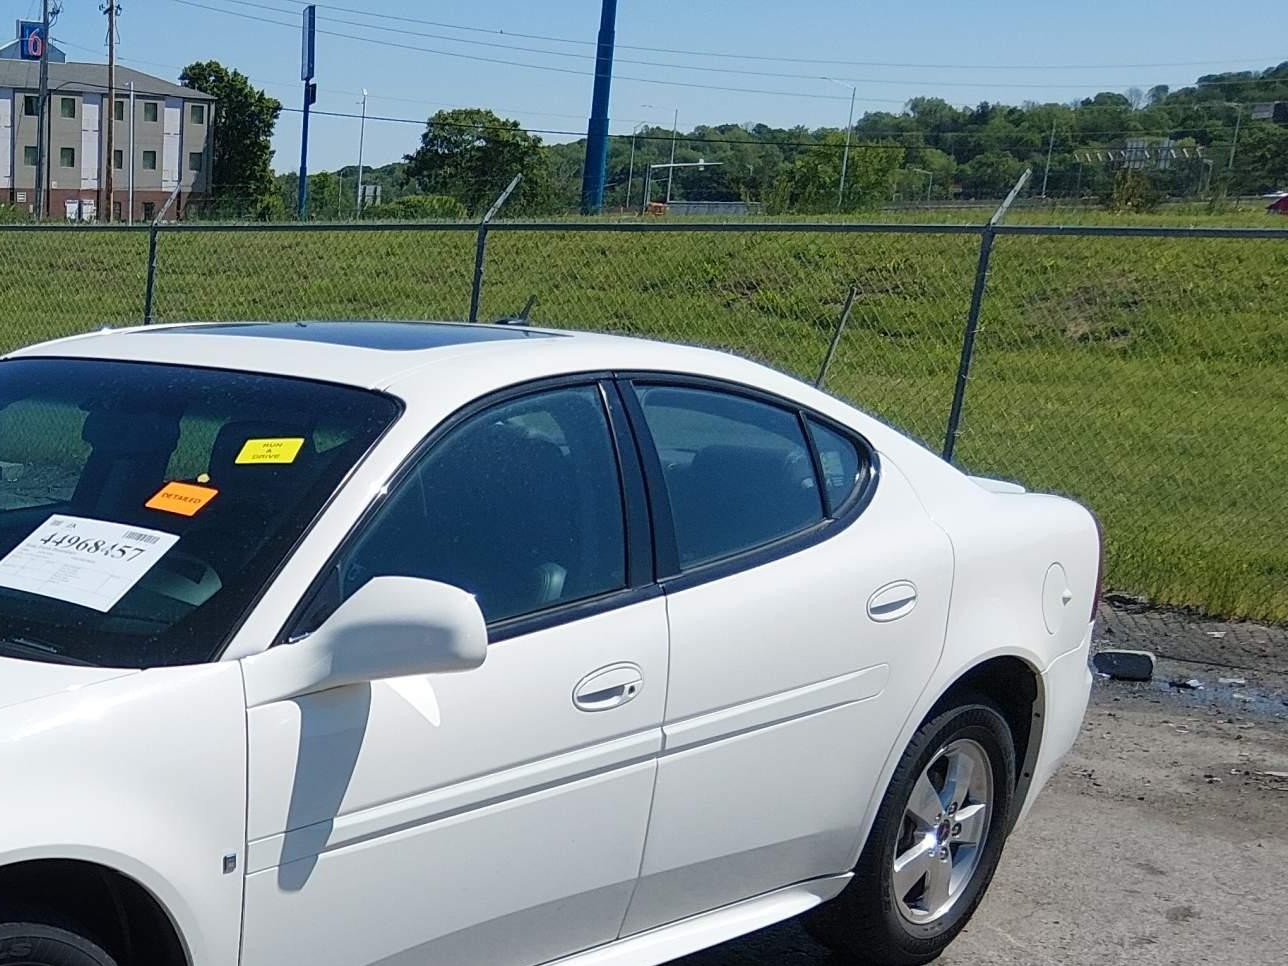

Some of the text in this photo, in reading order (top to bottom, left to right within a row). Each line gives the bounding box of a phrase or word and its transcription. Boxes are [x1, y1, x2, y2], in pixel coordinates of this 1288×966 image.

[28, 28, 43, 57] 6
[162, 492, 201, 504] DETAILED
[40, 532, 146, 562] 44968457
